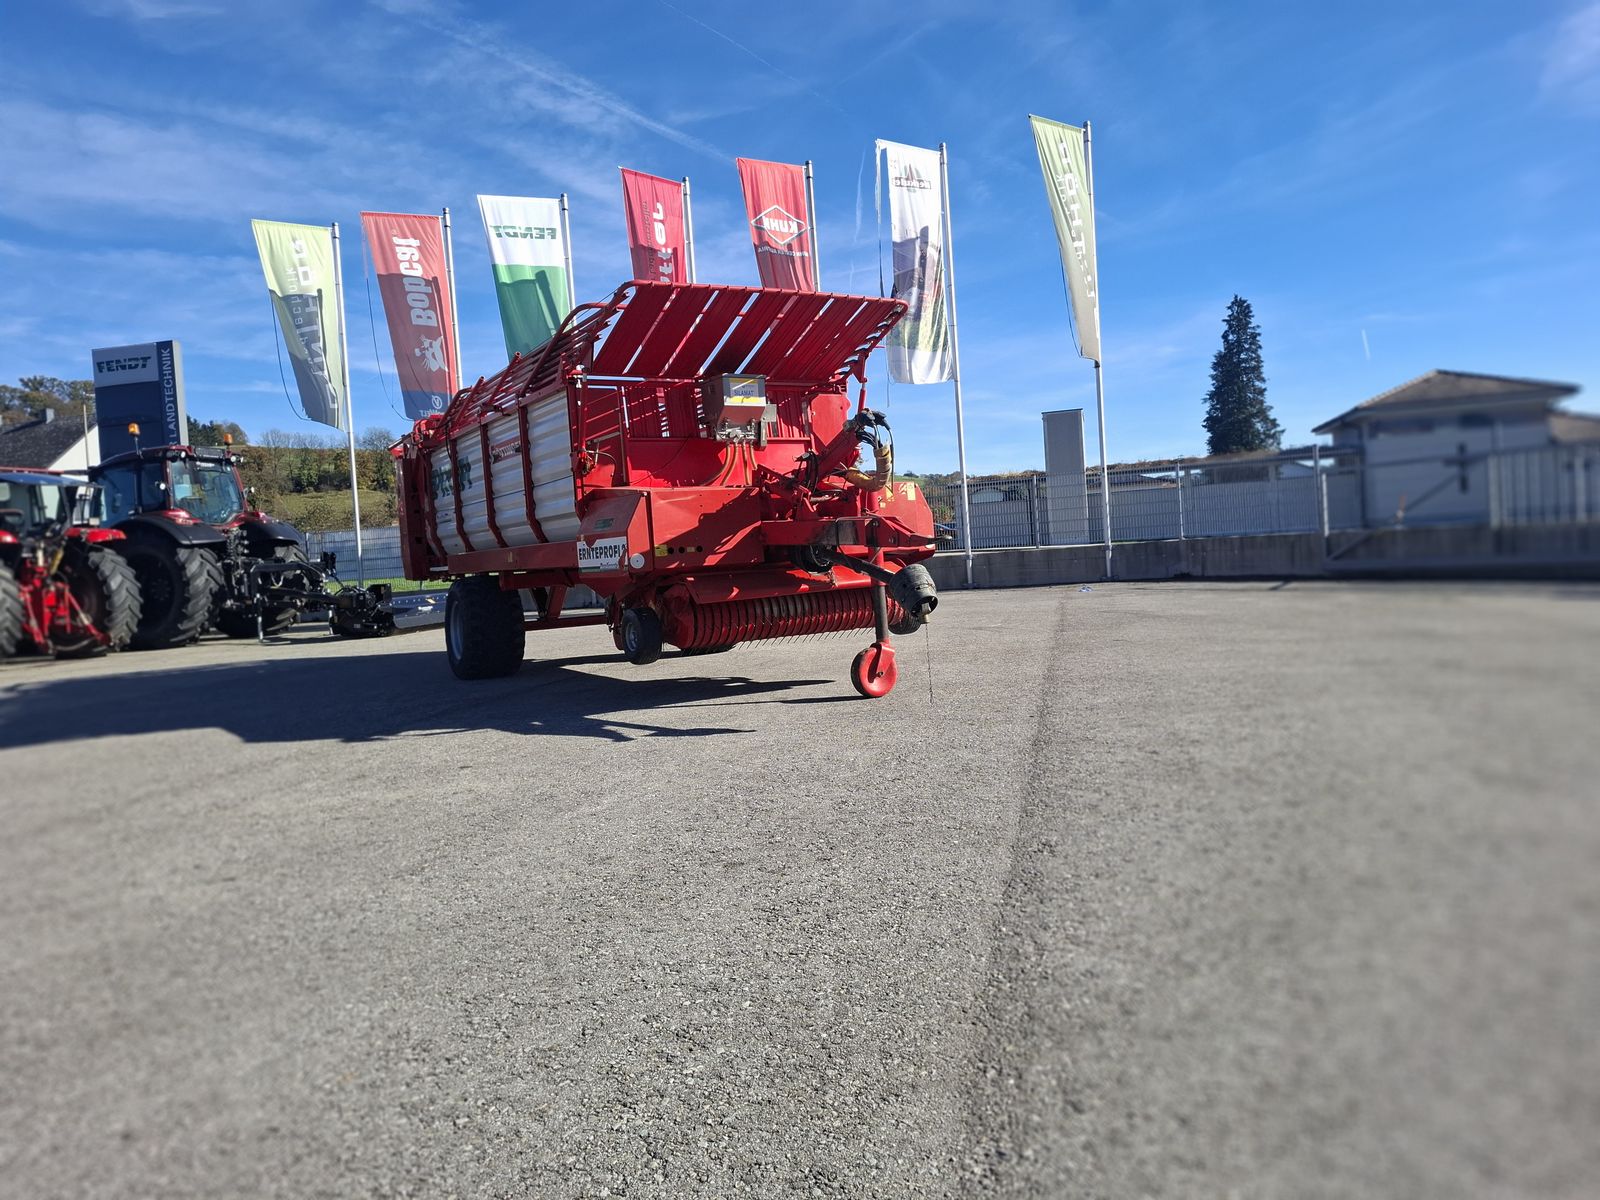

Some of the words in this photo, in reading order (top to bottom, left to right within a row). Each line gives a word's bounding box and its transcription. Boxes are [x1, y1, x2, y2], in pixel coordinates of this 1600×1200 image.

[96, 356, 152, 374] FENDT
[161, 348, 178, 438] LANDTECHNIK
[579, 544, 621, 561] ERNTEPROFI
